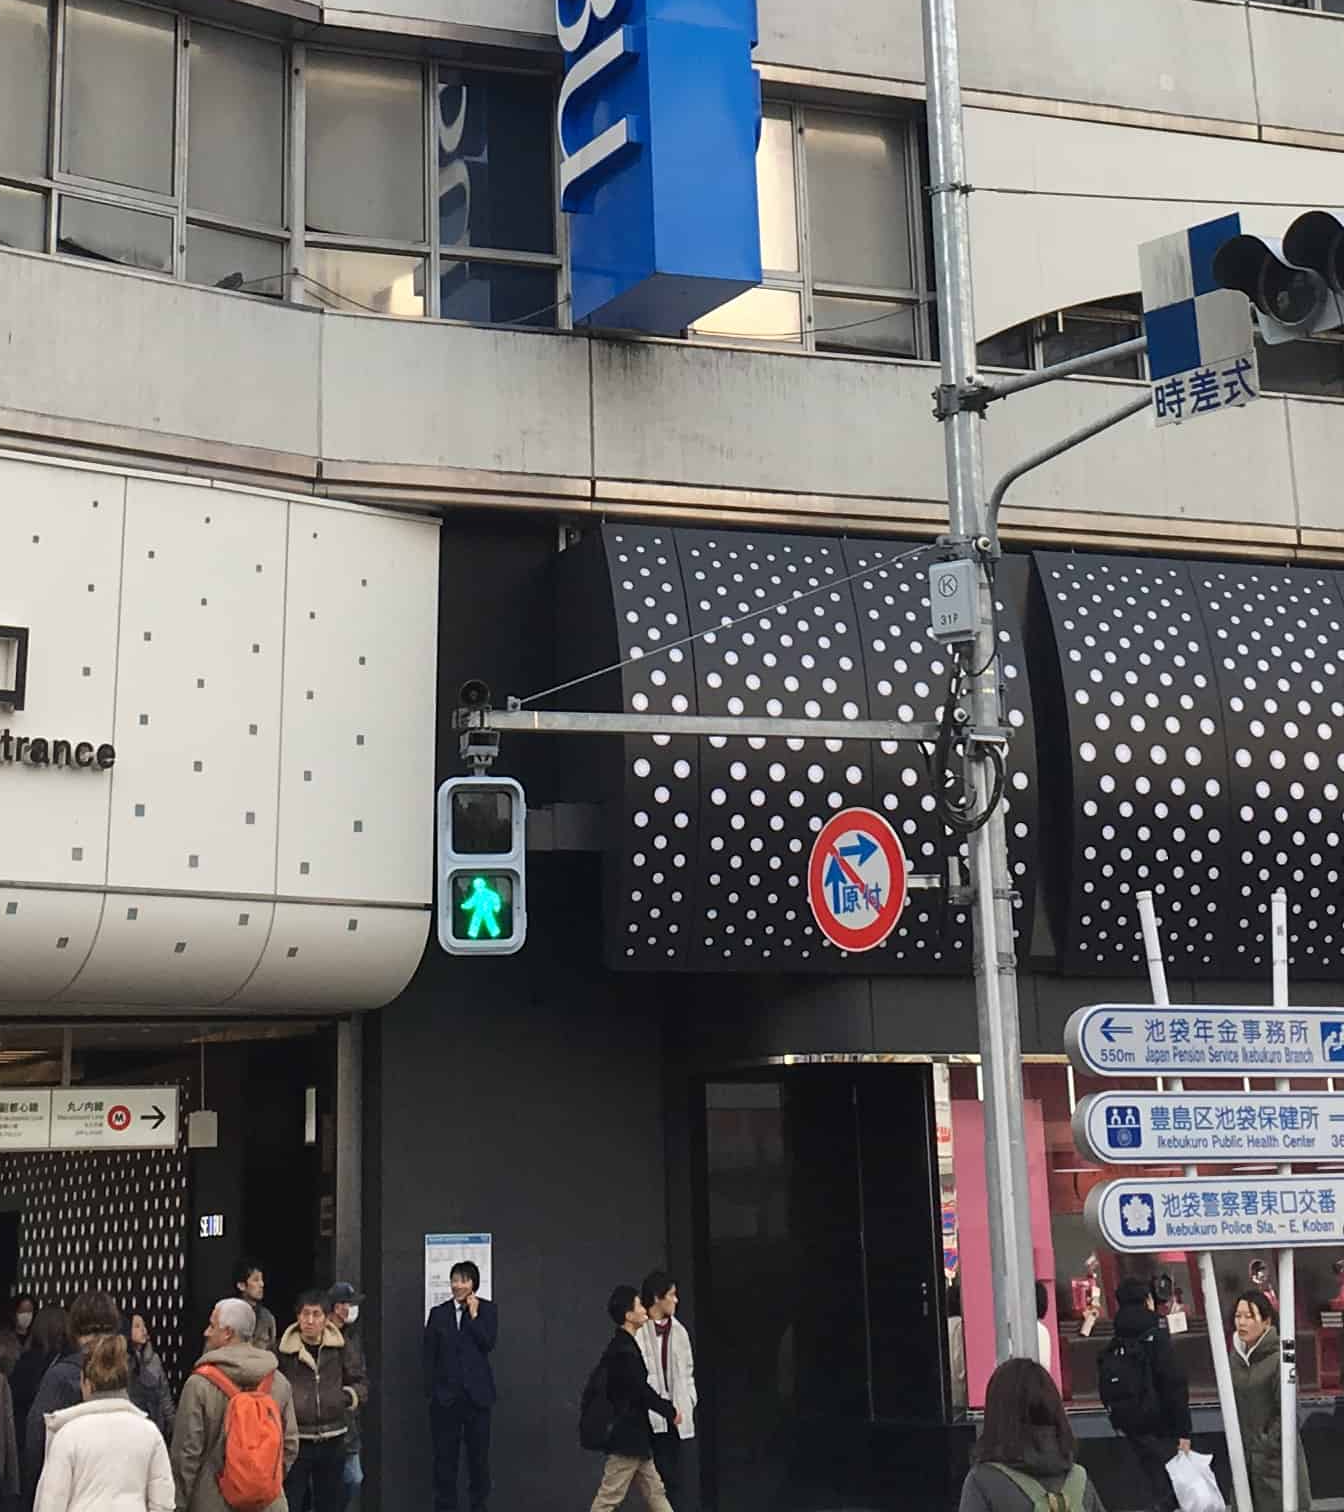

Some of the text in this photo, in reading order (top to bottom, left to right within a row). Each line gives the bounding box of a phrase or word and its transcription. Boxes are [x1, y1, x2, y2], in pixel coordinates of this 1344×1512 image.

[1154, 358, 1256, 422] 時差式
[1144, 1017, 1310, 1044] 池袋年金事務所
[1099, 1048, 1136, 1063] 550m
[1144, 1045, 1314, 1064] Japan Pension Service Ikebukuro Branch
[1150, 1105, 1320, 1131] 豊島区池袋保健所
[1157, 1134, 1209, 1150] Ikebukuro
[1211, 1134, 1244, 1149] Public
[1246, 1134, 1280, 1149] Health
[1282, 1134, 1316, 1149] Center
[1160, 1188, 1337, 1218] 池袋警察署東口交番
[1166, 1221, 1218, 1237] Ikebukuro
[1220, 1221, 1254, 1236] Police
[1302, 1219, 1335, 1233] Koban
